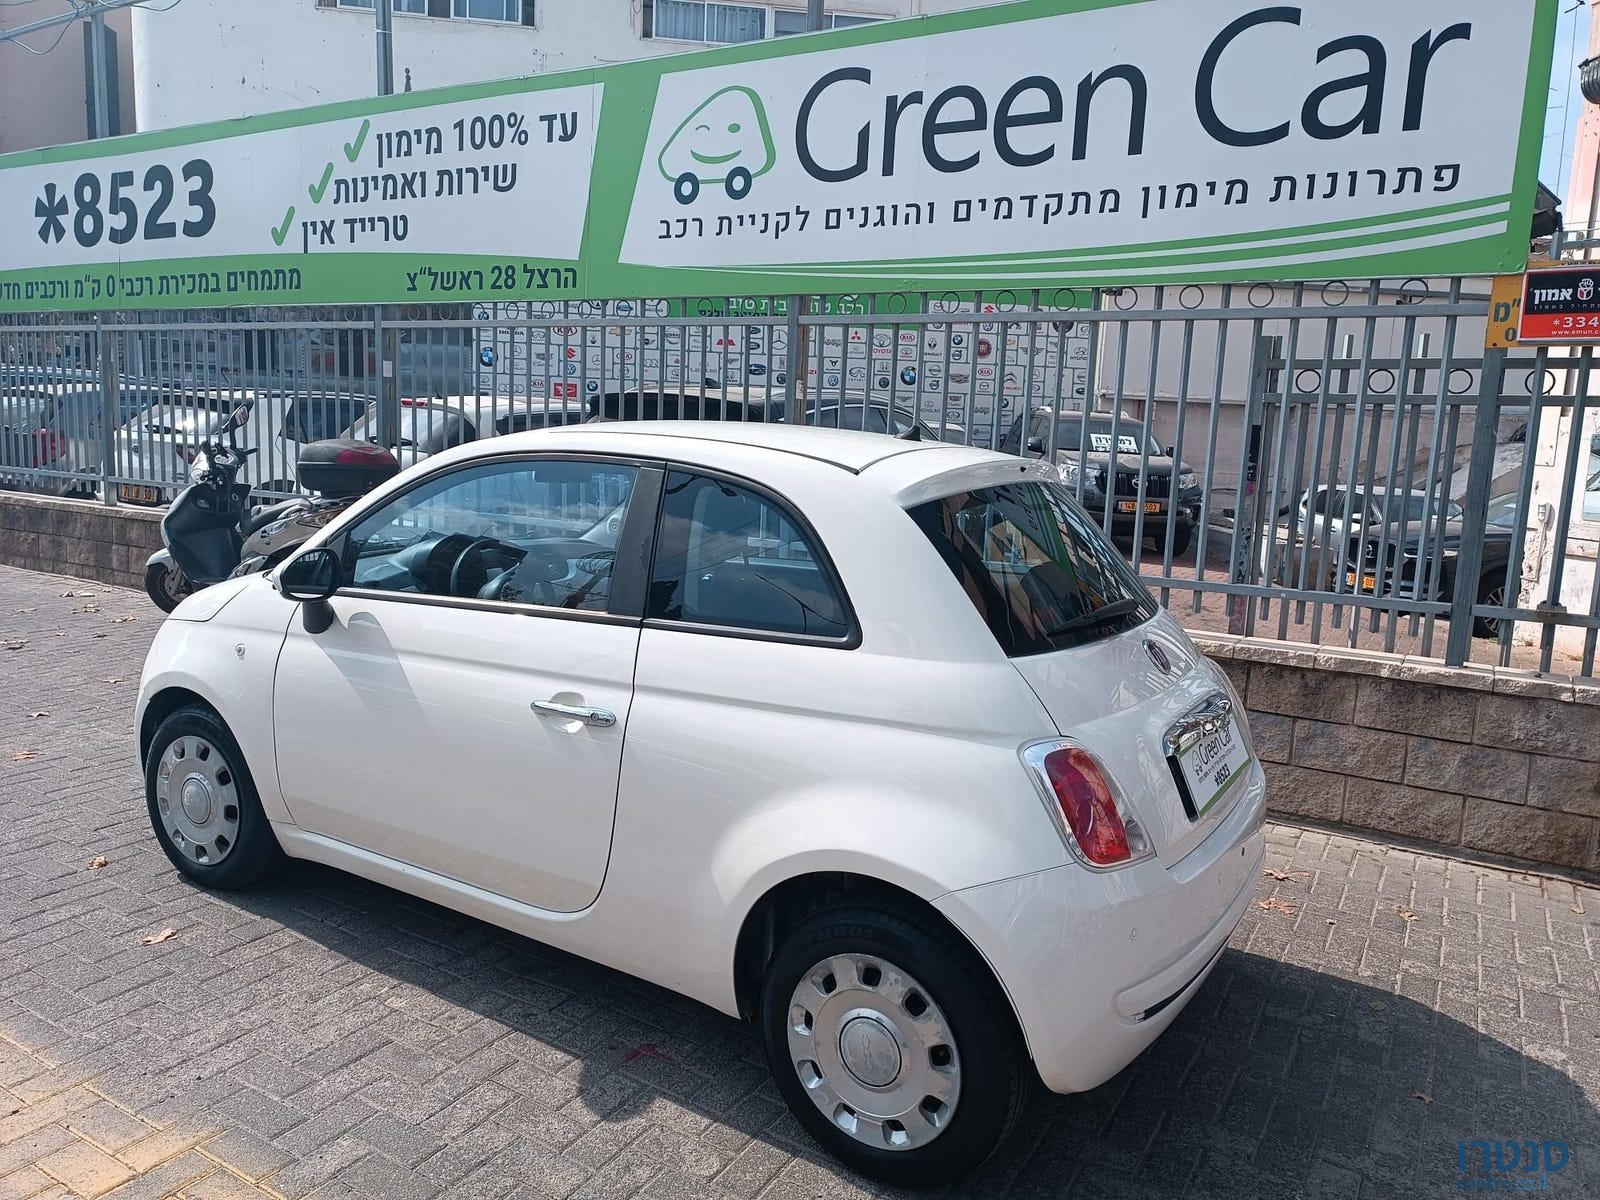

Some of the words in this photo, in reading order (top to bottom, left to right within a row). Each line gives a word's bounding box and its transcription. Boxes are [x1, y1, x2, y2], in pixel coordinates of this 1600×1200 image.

[796, 63, 1147, 183] Green
[1195, 6, 1471, 148] Car
[453, 112, 529, 151] 100%
[539, 111, 578, 143] עד
[376, 126, 442, 168] מימון
[333, 170, 426, 204] ואמינות
[435, 163, 517, 196] שירות
[1268, 163, 1461, 203] פתרונות
[953, 188, 1121, 225] מתקדמים
[1141, 178, 1249, 219] מימון
[343, 214, 409, 243] טרייד
[658, 214, 704, 240] רכב
[715, 205, 811, 240] לקניית
[824, 201, 935, 230] והוגנים
[302, 219, 335, 253] אין
[25, 279, 69, 300] ורכבים
[106, 274, 116, 297] 0
[119, 276, 153, 297] רכבי
[158, 271, 221, 296] במכירת
[227, 267, 301, 292] מתמחים
[490, 265, 516, 290] 28
[522, 263, 578, 290] הרצל
[1533, 288, 1573, 305] אמון
